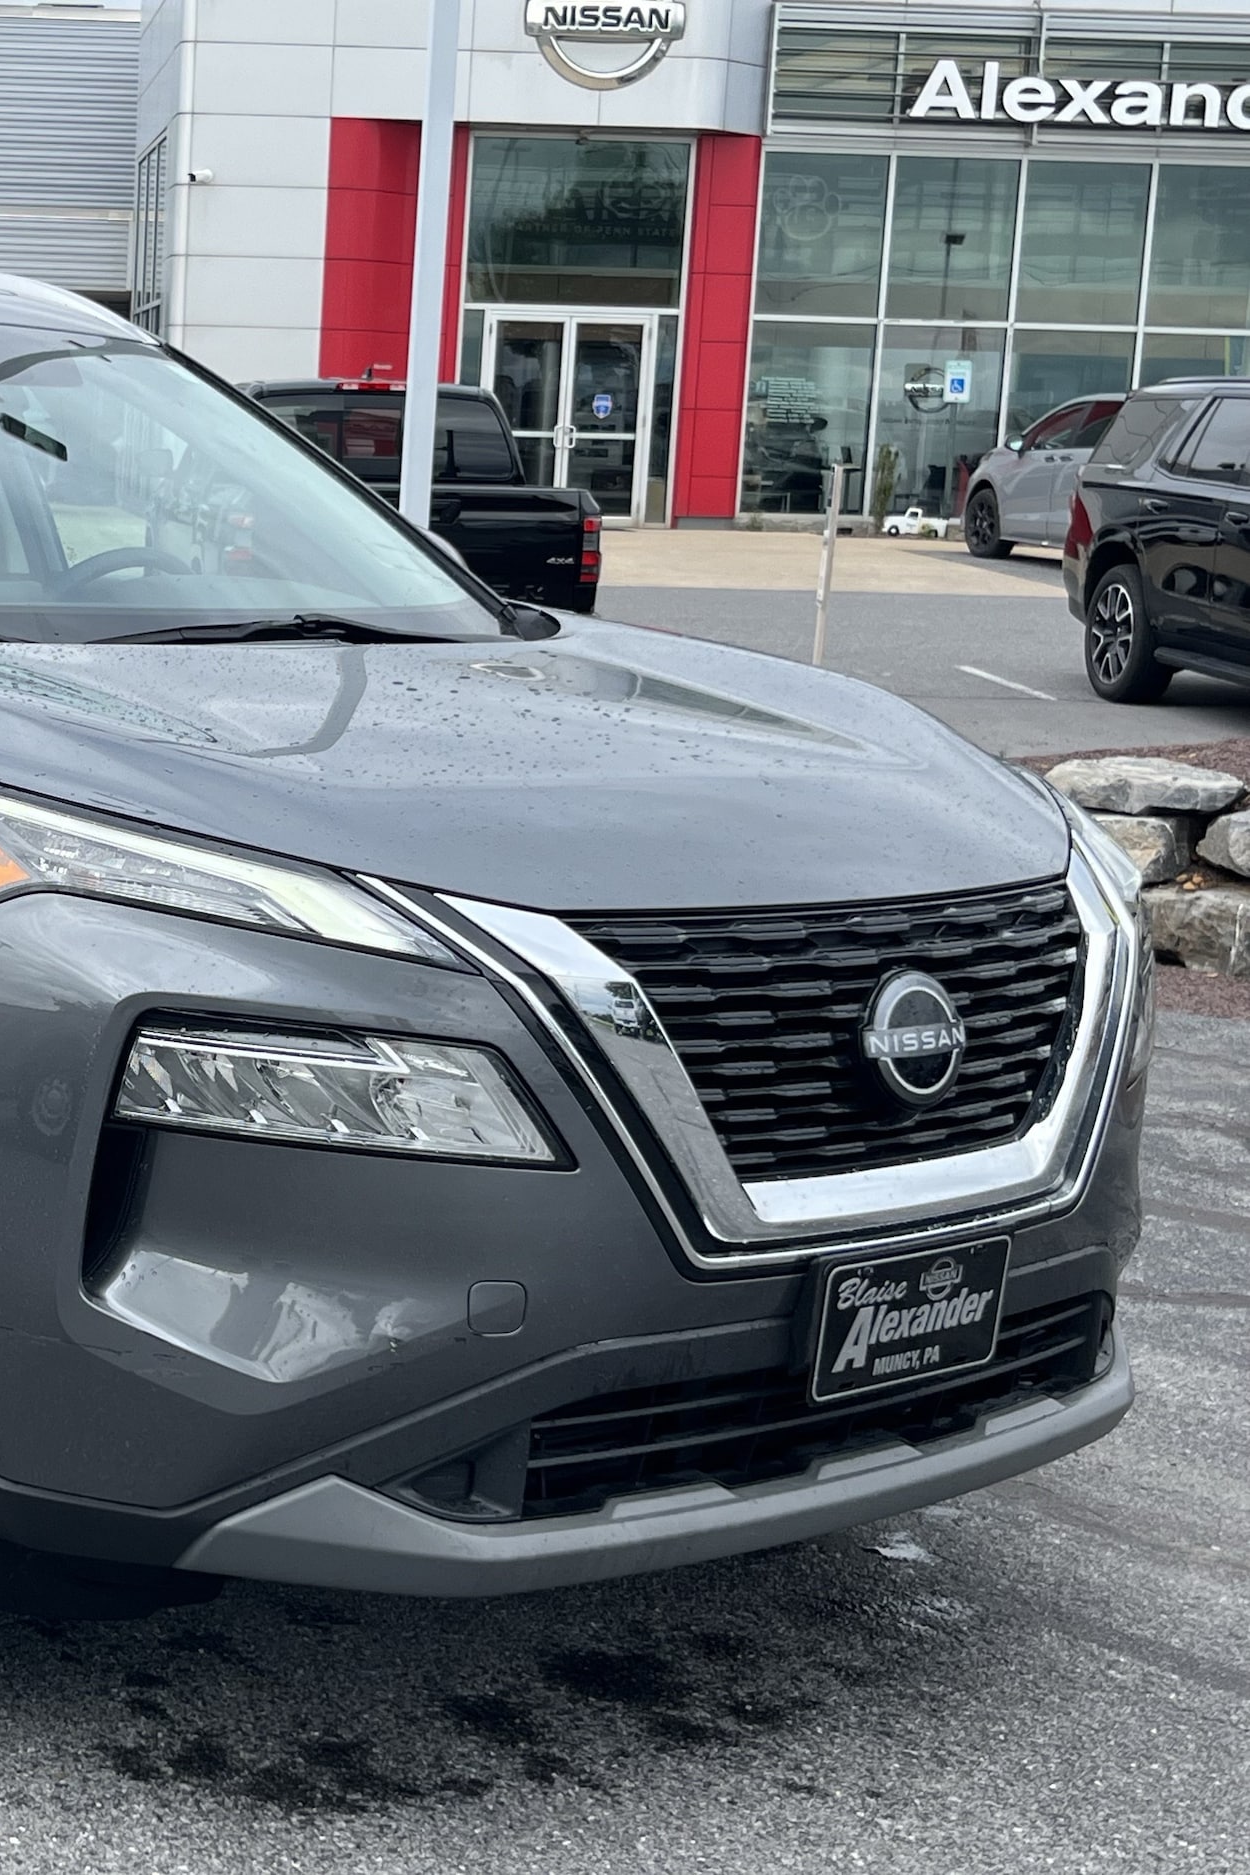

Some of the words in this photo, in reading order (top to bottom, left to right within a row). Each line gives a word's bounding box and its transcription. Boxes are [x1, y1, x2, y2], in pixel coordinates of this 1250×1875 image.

[543, 6, 671, 31] NISSAN
[869, 1026, 964, 1054] NISSAN
[837, 1277, 908, 1310] Blaise
[925, 1268, 958, 1283] NISSAN
[831, 1288, 994, 1373] Alexander
[872, 1349, 921, 1376] MUNCY,
[922, 1345, 940, 1365] PA
